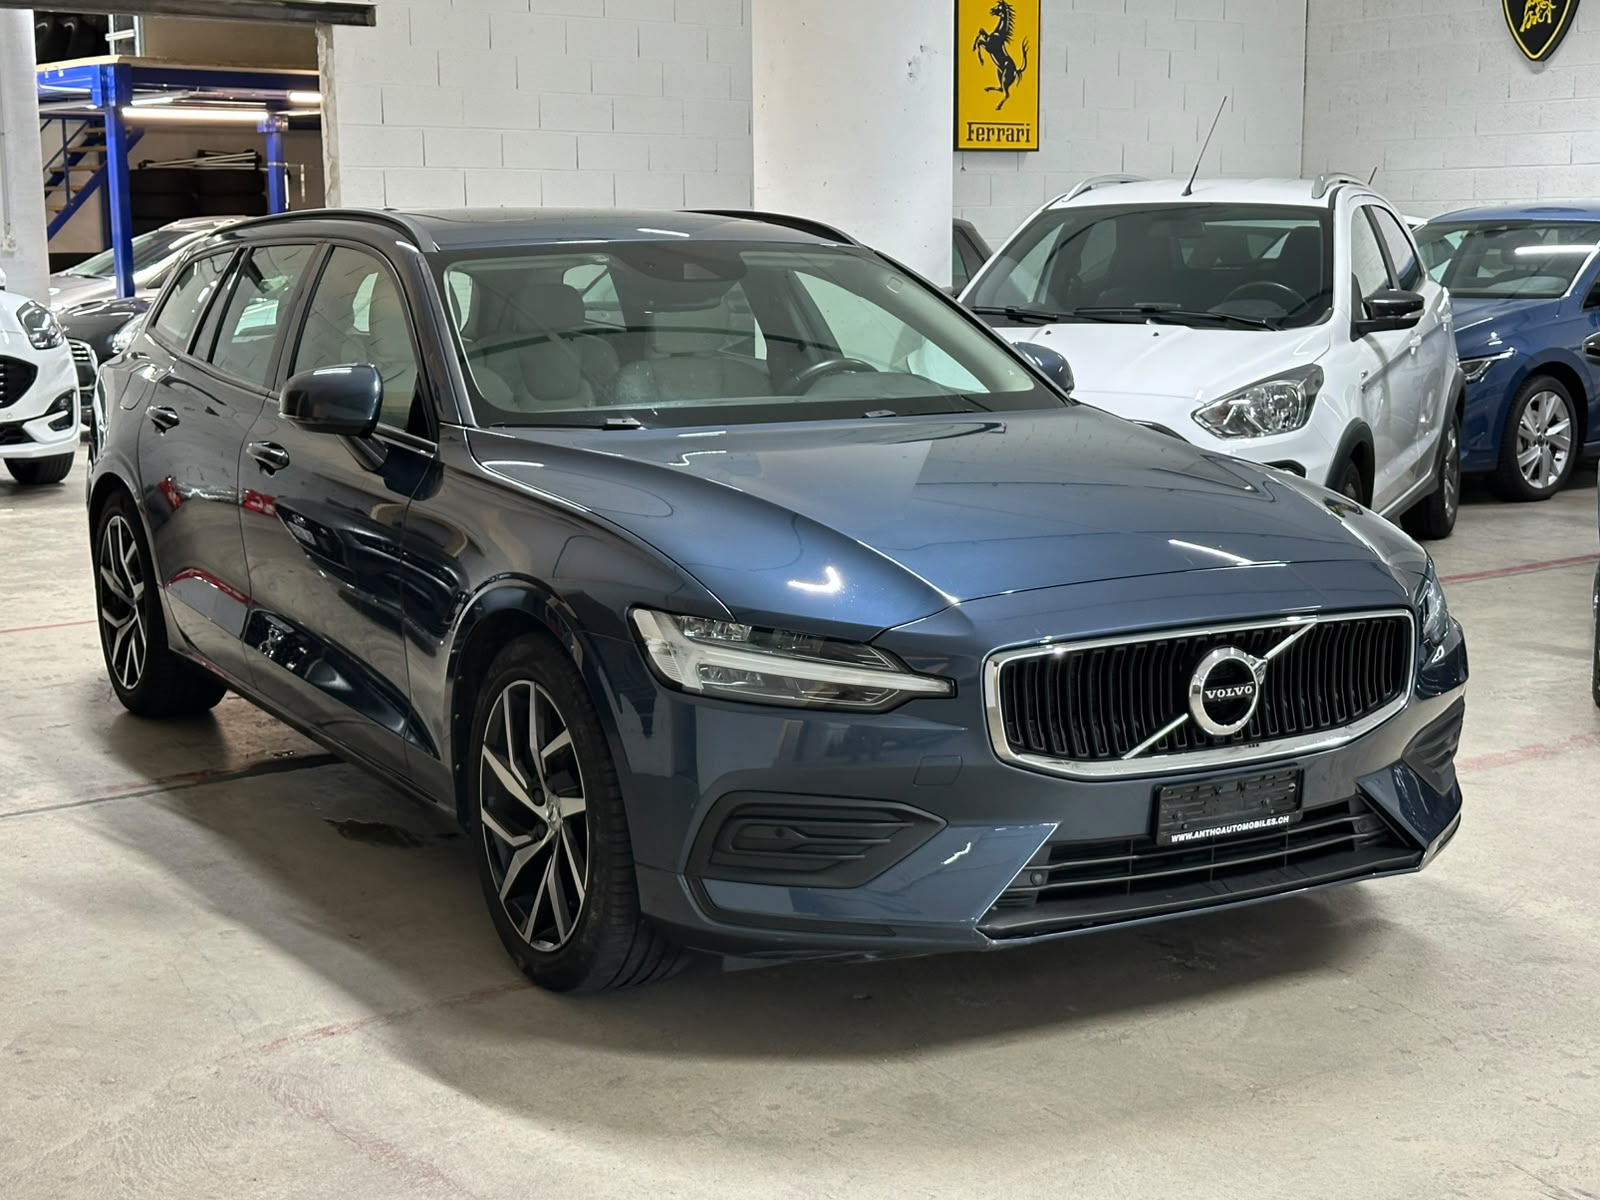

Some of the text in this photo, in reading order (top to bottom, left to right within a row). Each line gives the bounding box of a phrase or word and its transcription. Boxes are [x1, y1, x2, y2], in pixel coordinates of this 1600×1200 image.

[966, 122, 1031, 143] Ferrari
[1205, 685, 1253, 699] VOLVO
[1171, 815, 1290, 842] WWW.ANTHOAUTOMOBILES.CH
